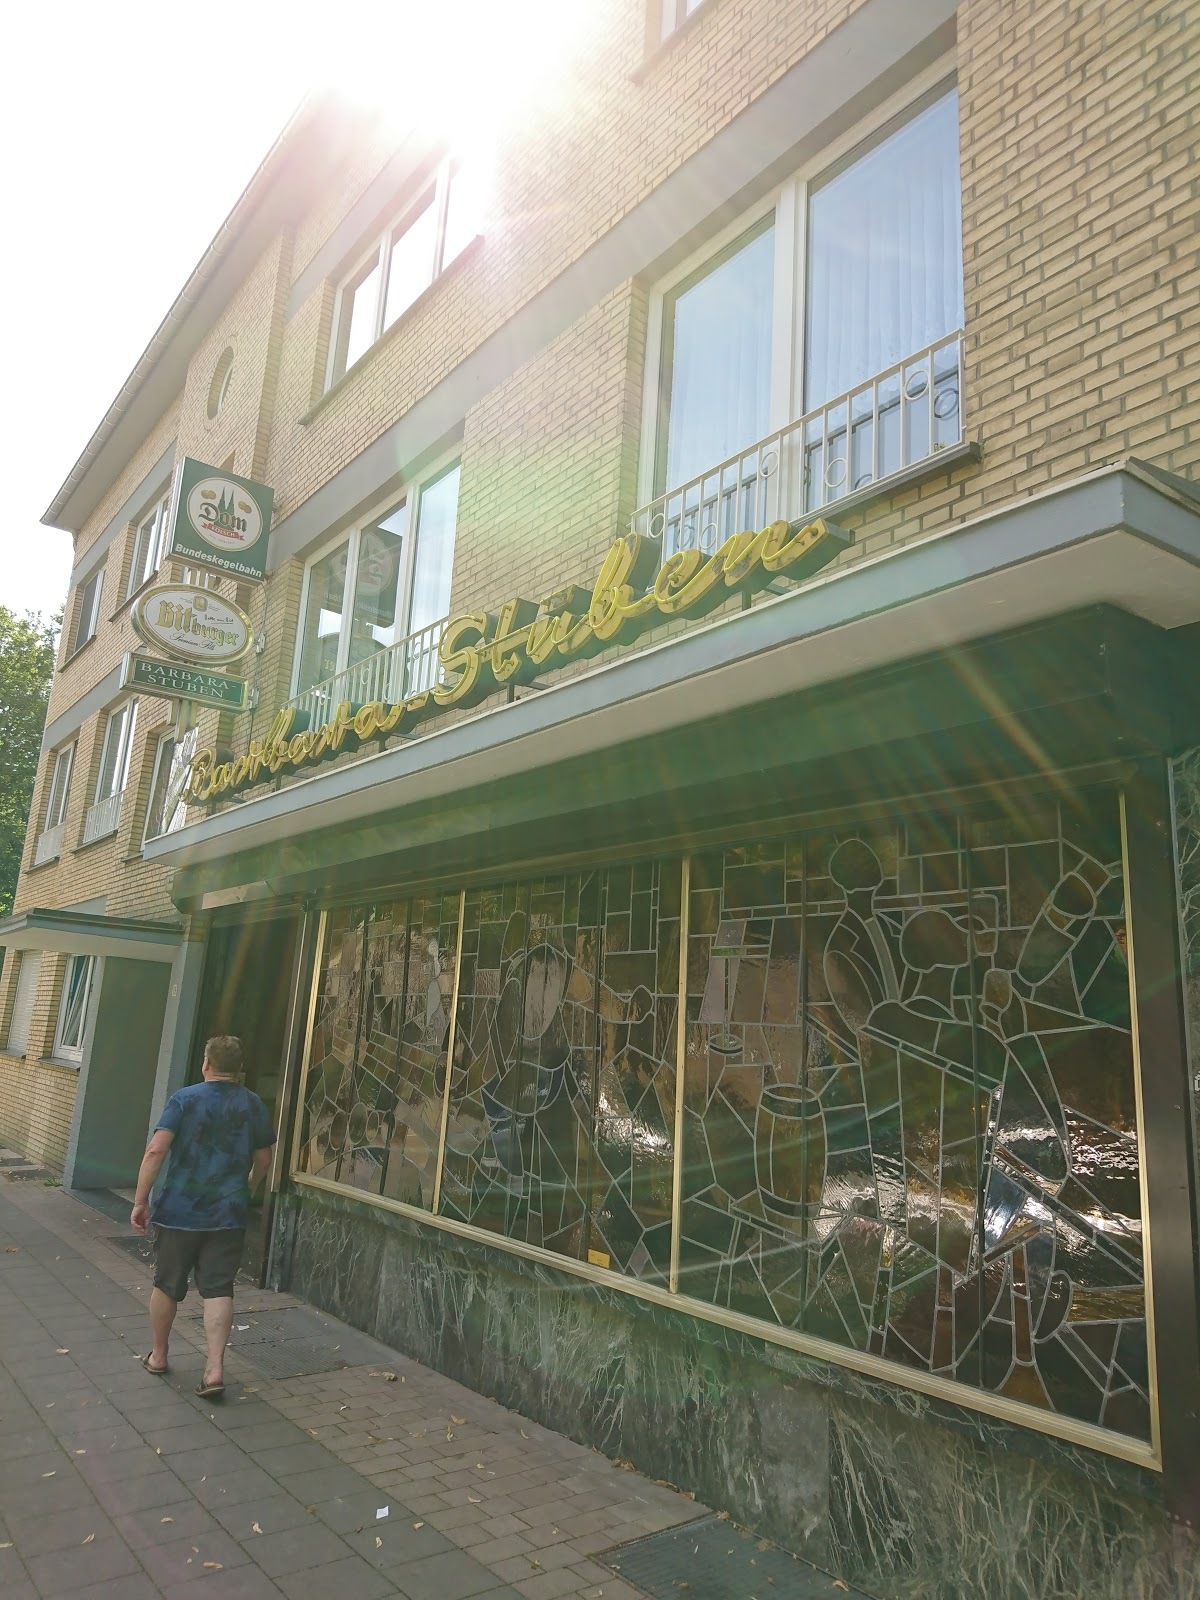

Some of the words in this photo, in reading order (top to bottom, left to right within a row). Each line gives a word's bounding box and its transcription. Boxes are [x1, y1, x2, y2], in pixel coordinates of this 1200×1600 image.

[198, 502, 248, 532] Dom
[175, 543, 262, 578] Bundeskegelbahn
[155, 599, 240, 647] Bitburger
[141, 663, 237, 690] BARBARA-
[147, 674, 224, 698] STUBEN
